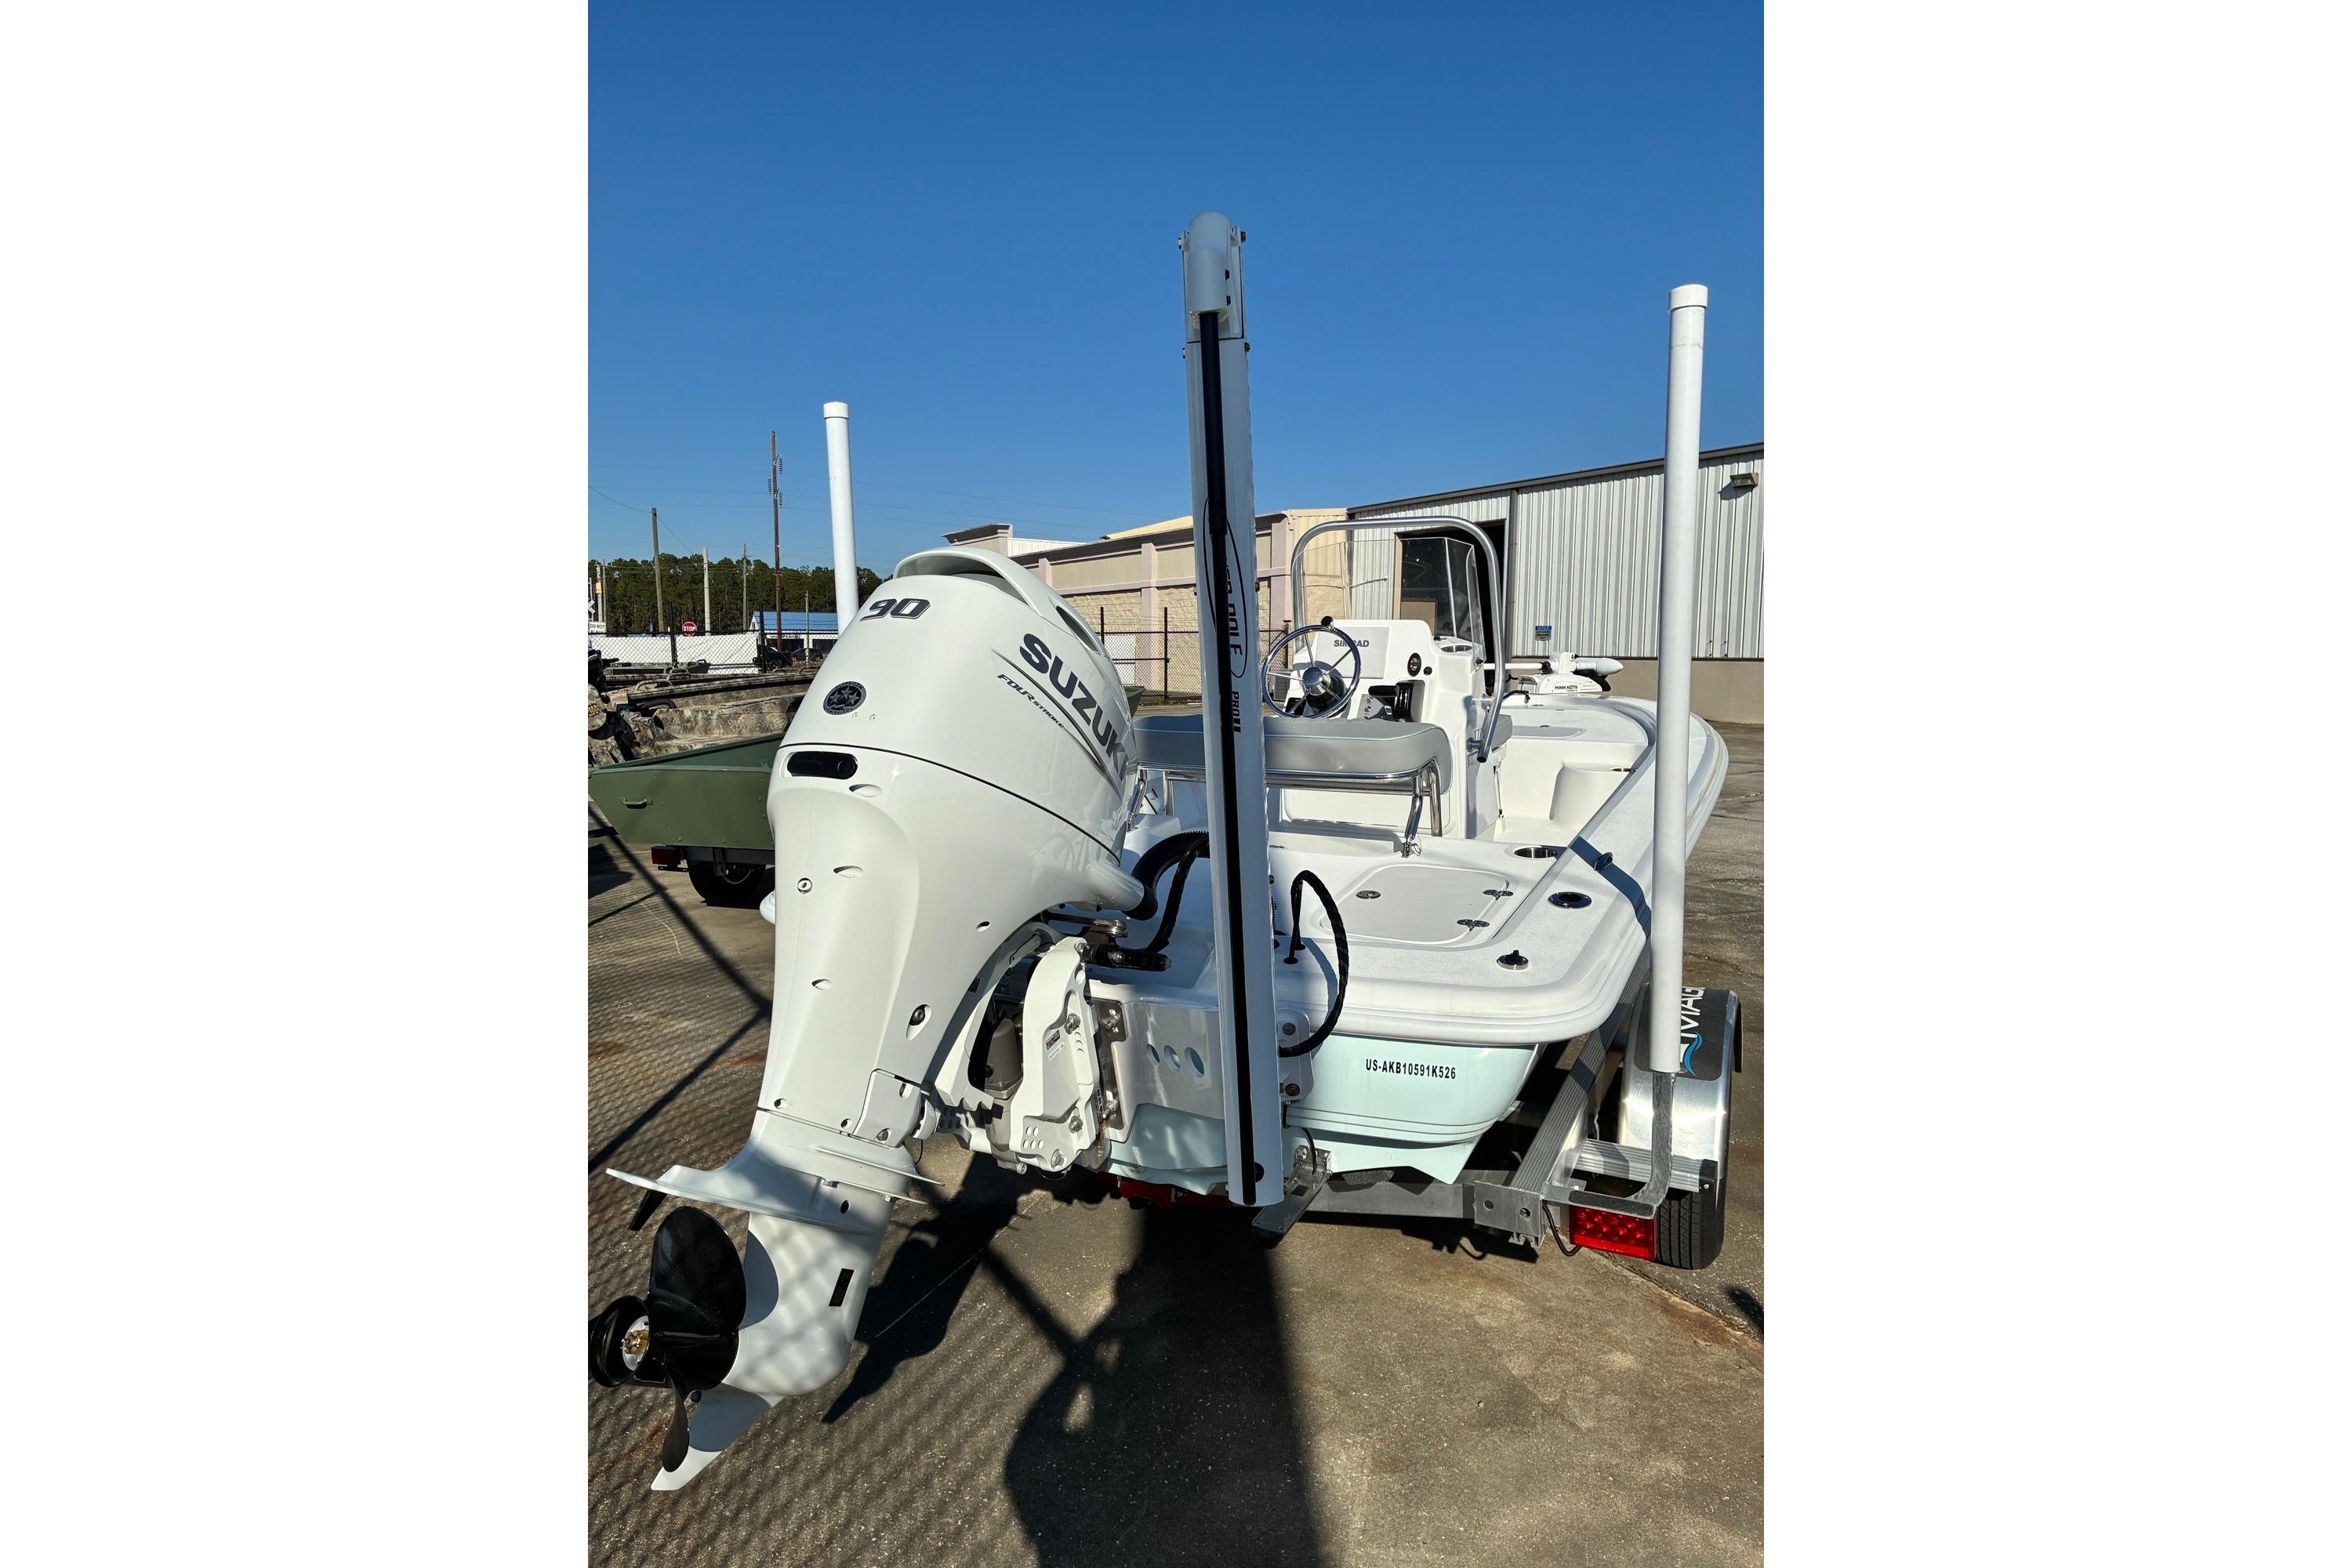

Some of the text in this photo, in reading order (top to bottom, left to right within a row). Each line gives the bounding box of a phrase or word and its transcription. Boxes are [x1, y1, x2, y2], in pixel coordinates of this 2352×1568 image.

[860, 598, 931, 622] 90
[1019, 633, 1129, 782] SUZUKI
[1366, 1058, 1456, 1080] US-AKB10591K526
